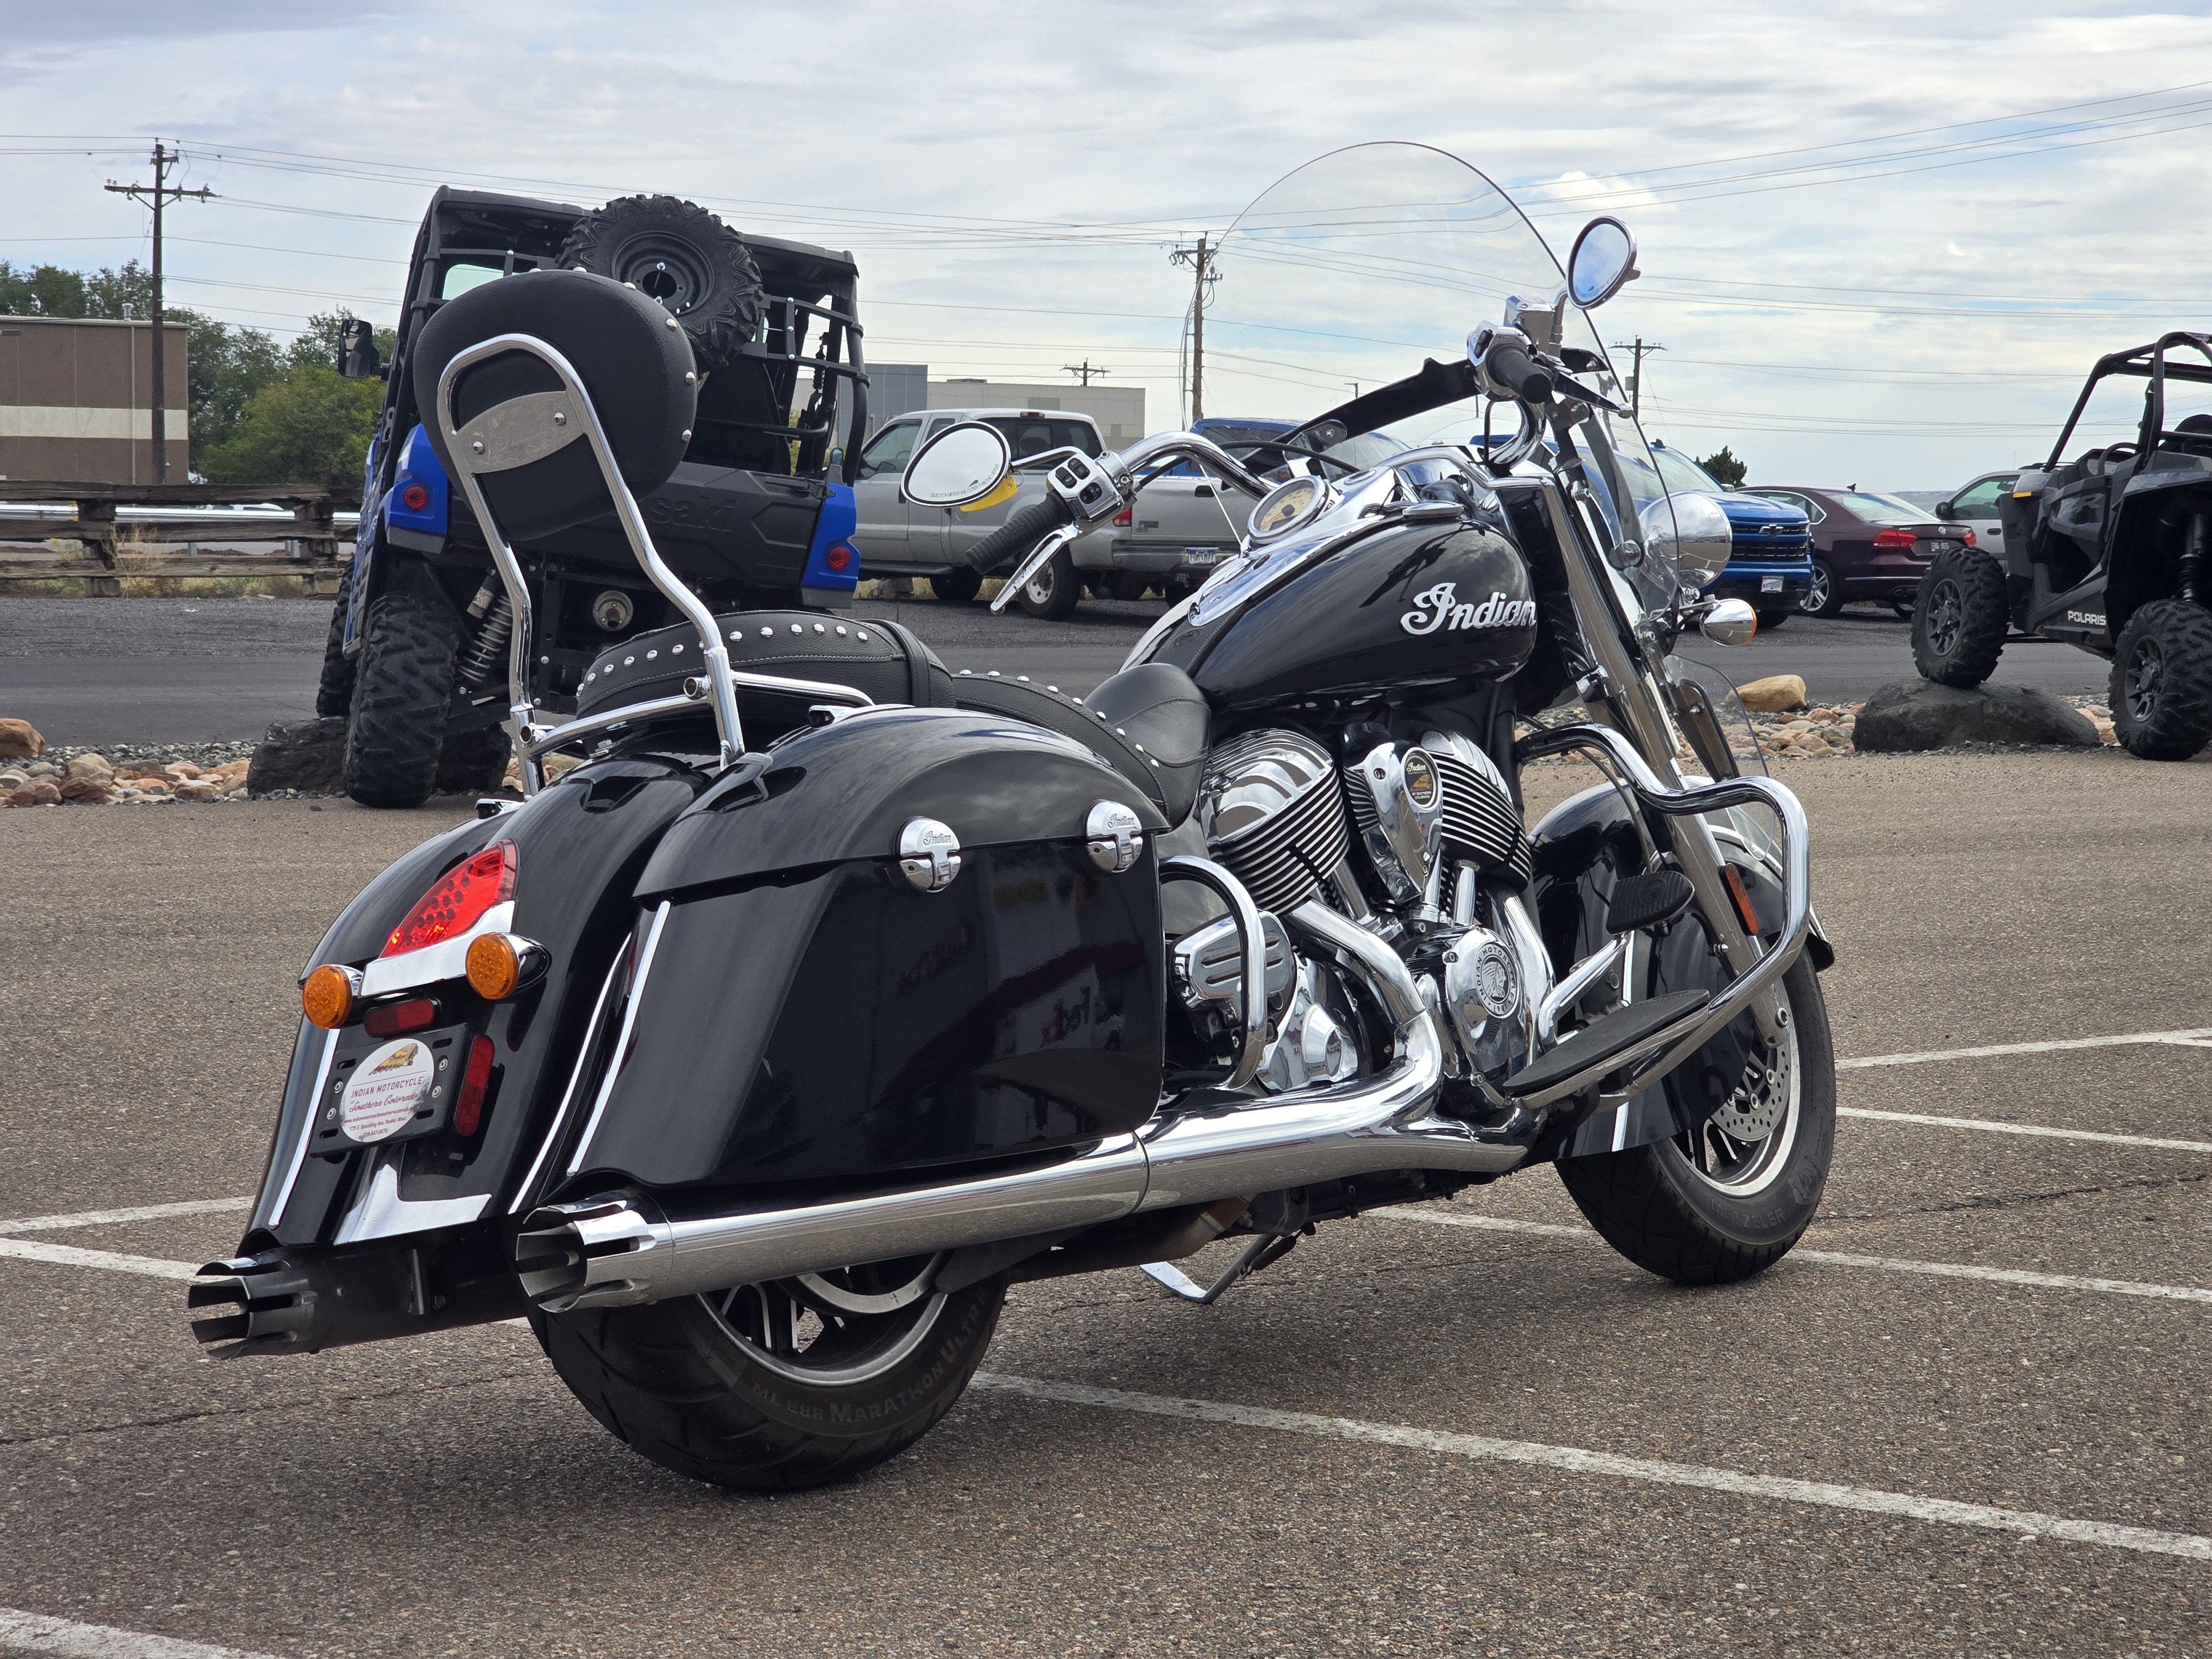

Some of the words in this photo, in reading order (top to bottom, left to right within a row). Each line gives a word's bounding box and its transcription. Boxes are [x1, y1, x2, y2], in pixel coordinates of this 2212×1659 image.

[645, 497, 735, 532] saki
[1400, 582, 1536, 635] Indian
[2067, 610, 2106, 626] POLARIS
[1406, 762, 1426, 772] Indian
[1107, 813, 1135, 828] Indian
[923, 831, 952, 846] Indian
[1475, 956, 1487, 1001] INDIAN
[1482, 946, 1516, 999] MOTORCYCLE
[351, 1086, 375, 1099] INDIAN
[376, 1076, 425, 1093] MOTORCYCLE
[349, 1099, 383, 1113] Southern
[383, 1092, 419, 1106] Colorado
[1710, 1196, 1787, 1230] METZELER
